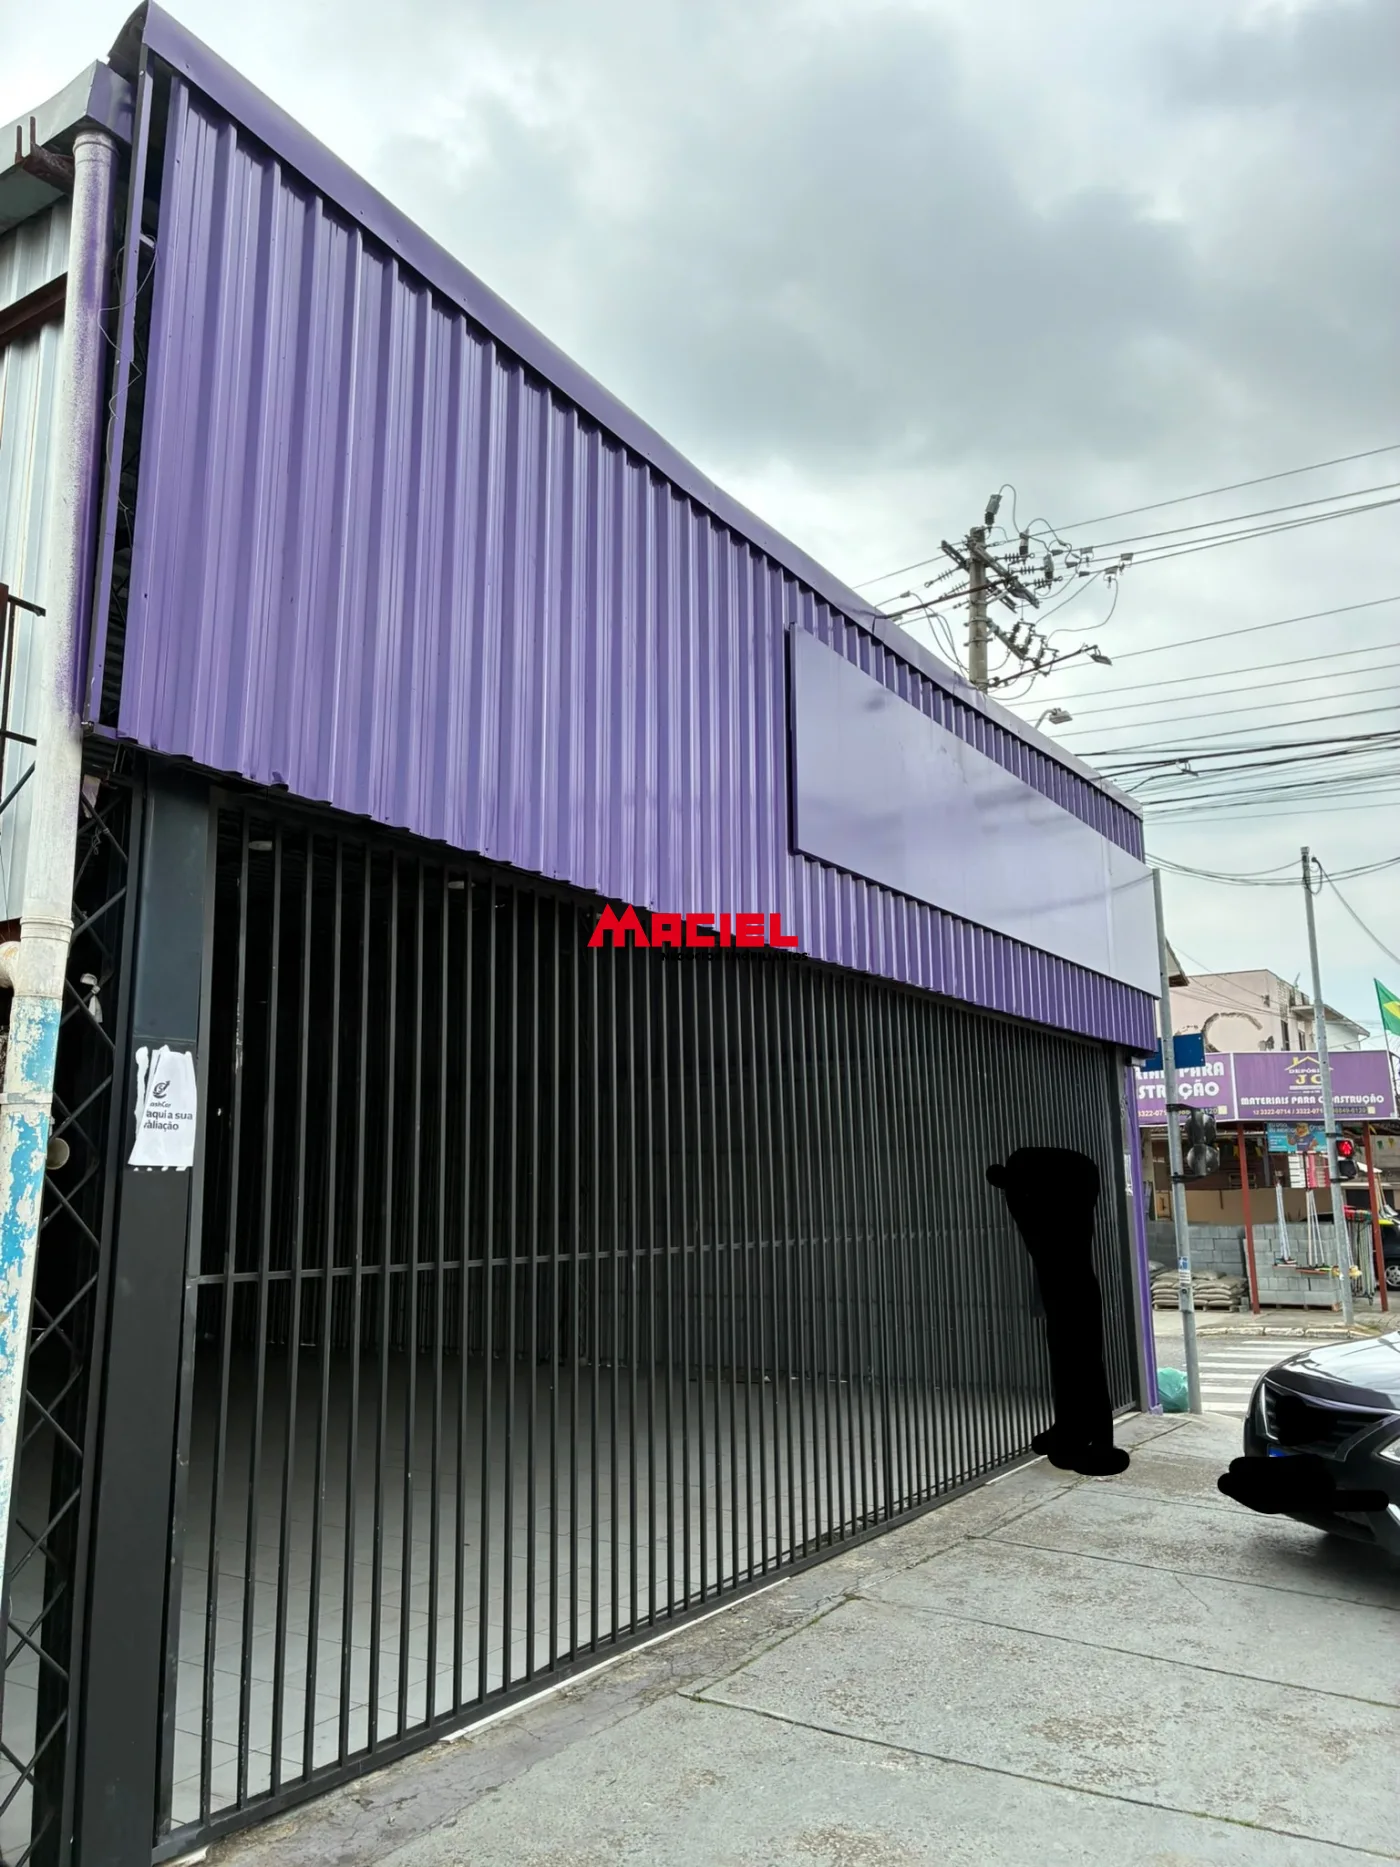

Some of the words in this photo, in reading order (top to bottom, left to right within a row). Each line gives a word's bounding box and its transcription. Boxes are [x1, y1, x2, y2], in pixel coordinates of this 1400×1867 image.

[1138, 1079, 1220, 1100] STRÇÃO
[1240, 1096, 1289, 1105] MATERIAIS
[1291, 1096, 1316, 1105] PARA
[1318, 1094, 1384, 1104] CNSTRUÇÃO
[146, 1110, 167, 1119] aqui
